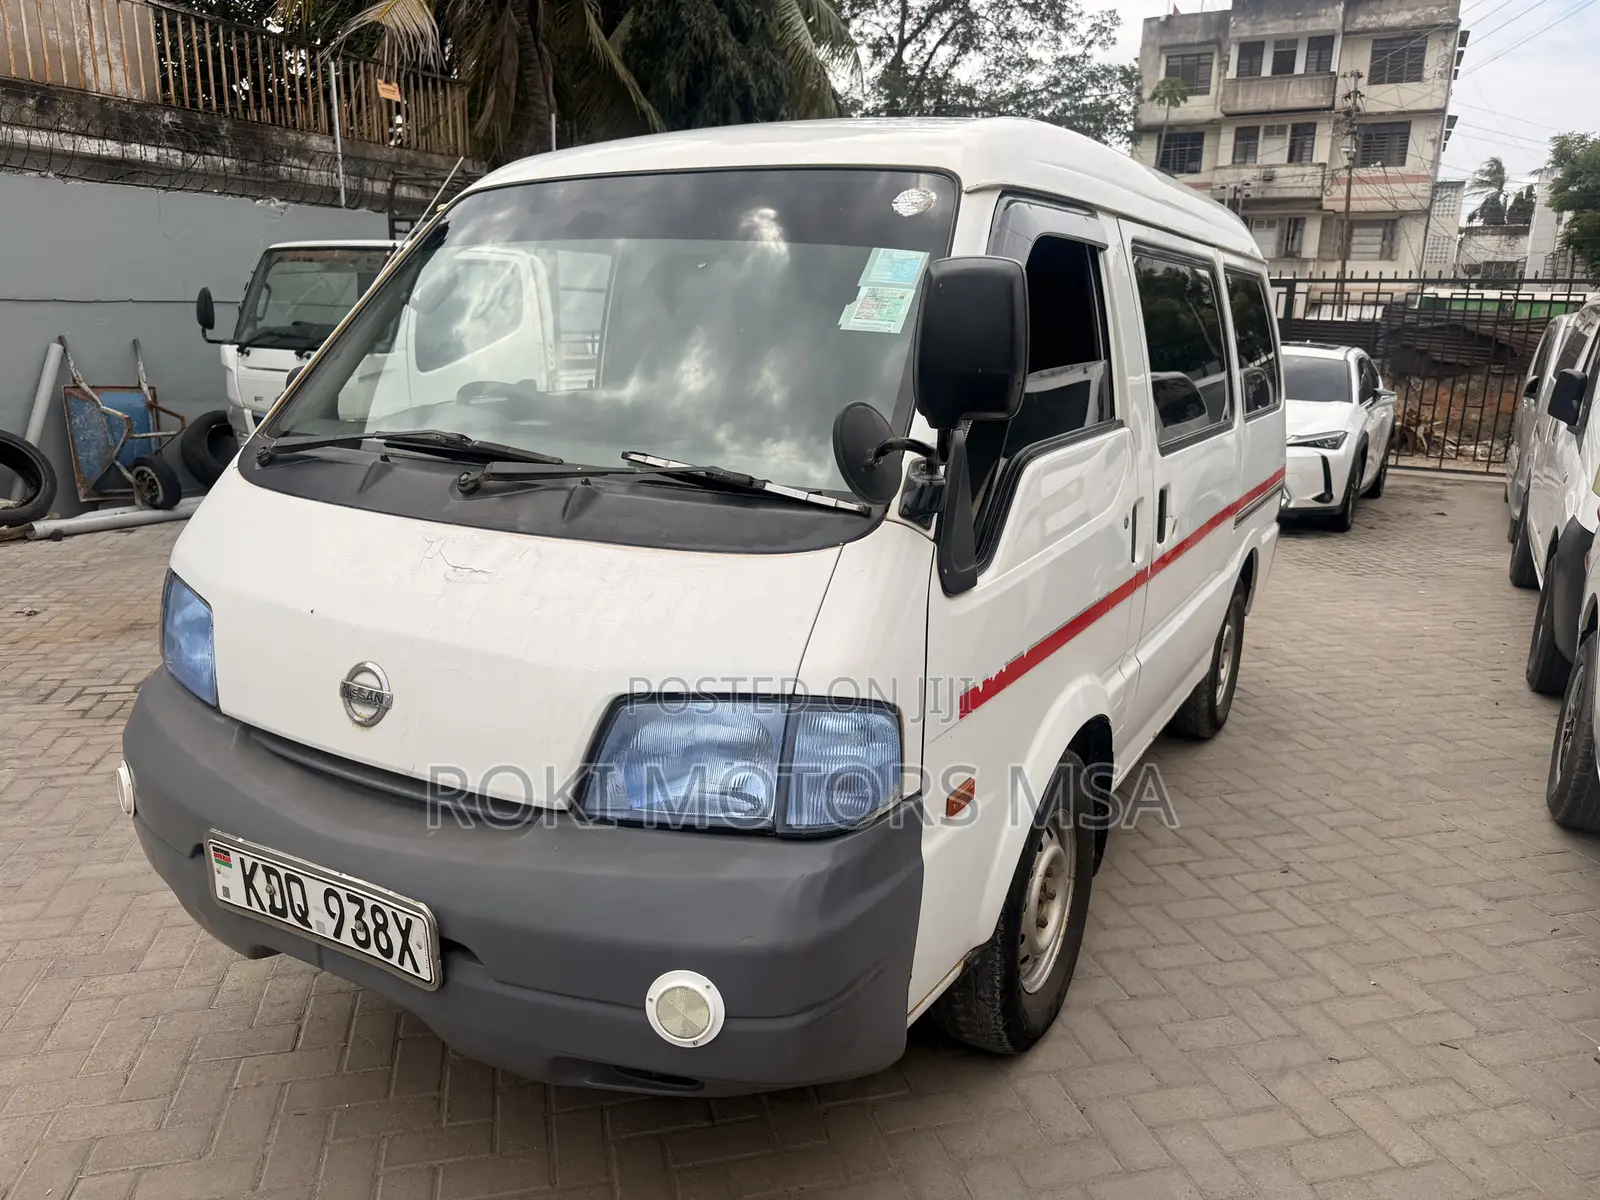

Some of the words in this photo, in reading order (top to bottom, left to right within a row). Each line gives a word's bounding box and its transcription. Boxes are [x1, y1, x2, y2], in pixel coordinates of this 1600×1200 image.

[342, 682, 385, 704] NISSAN
[240, 857, 312, 929] KDQ
[323, 887, 421, 974] 938X
